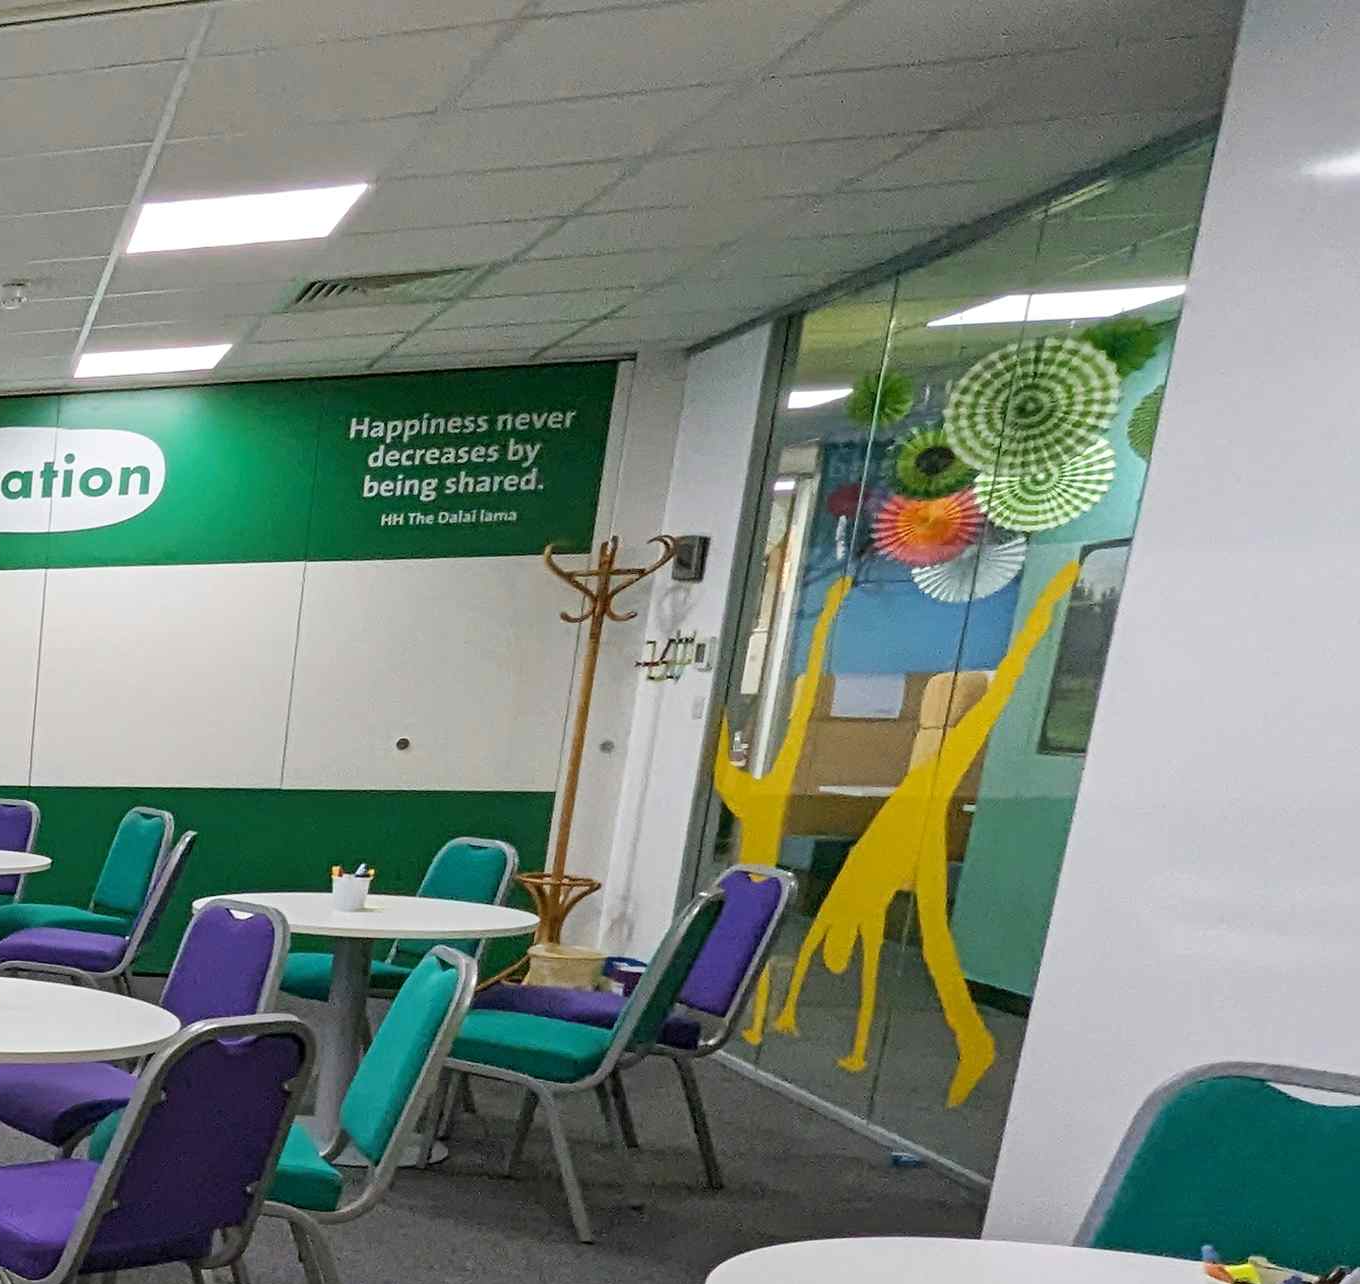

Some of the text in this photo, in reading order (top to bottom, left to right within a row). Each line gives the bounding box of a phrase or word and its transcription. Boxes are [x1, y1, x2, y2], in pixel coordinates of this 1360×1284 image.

[349, 409, 576, 442] Happiness never
[368, 438, 543, 468] decreases by
[362, 468, 544, 502] being shared.
[380, 513, 404, 526] HH
[407, 512, 434, 525] The
[438, 510, 477, 524] Dalai
